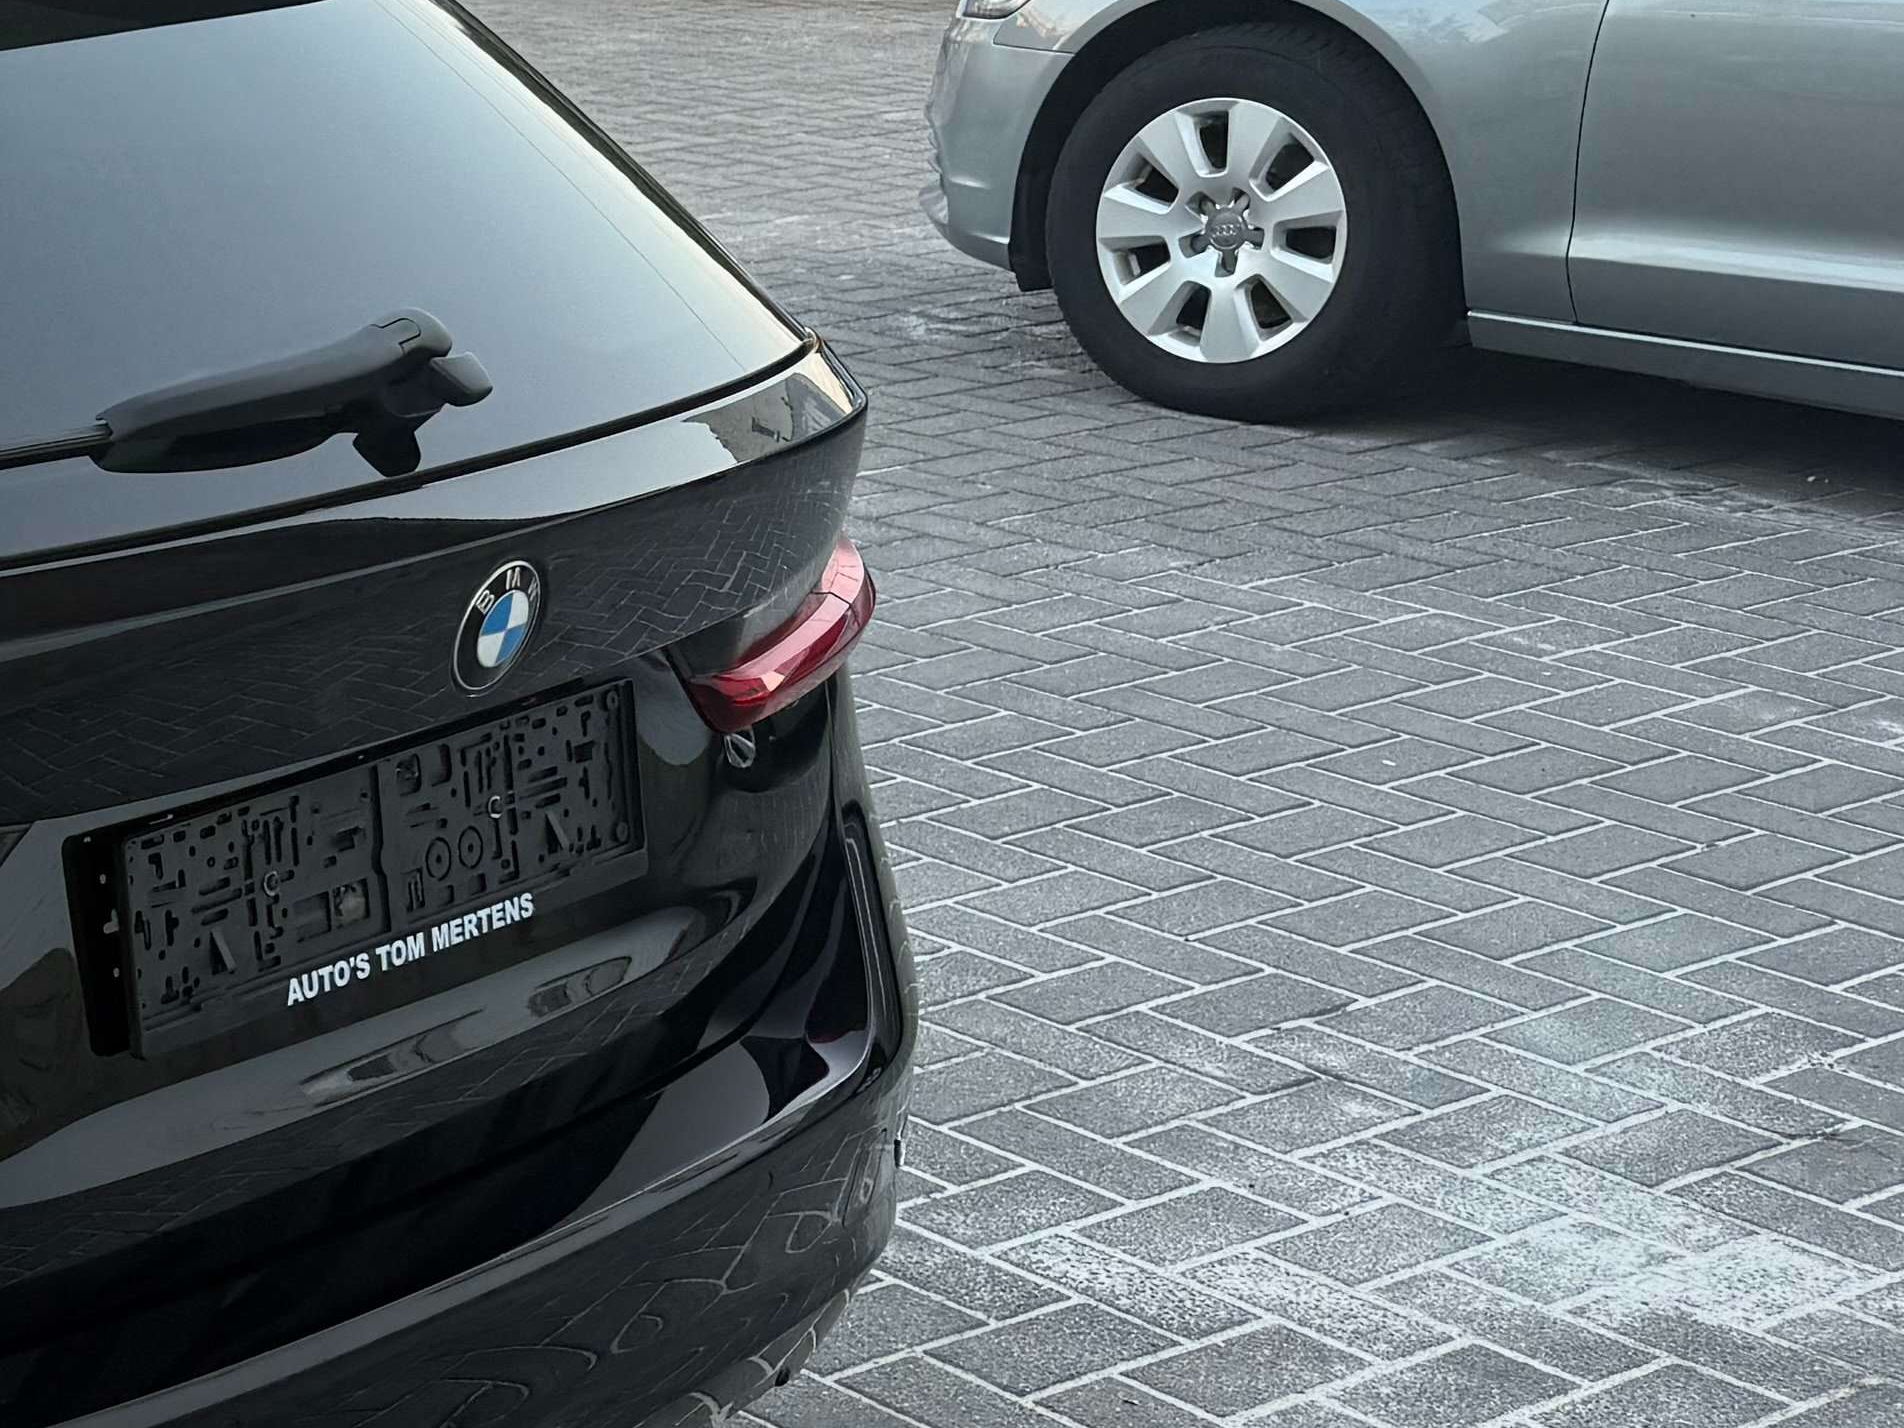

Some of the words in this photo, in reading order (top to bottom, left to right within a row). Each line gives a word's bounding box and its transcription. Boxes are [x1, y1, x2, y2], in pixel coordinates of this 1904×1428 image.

[287, 952, 371, 1007] AUTO'S
[376, 932, 425, 972] TOM
[430, 892, 535, 953] MERTENS
